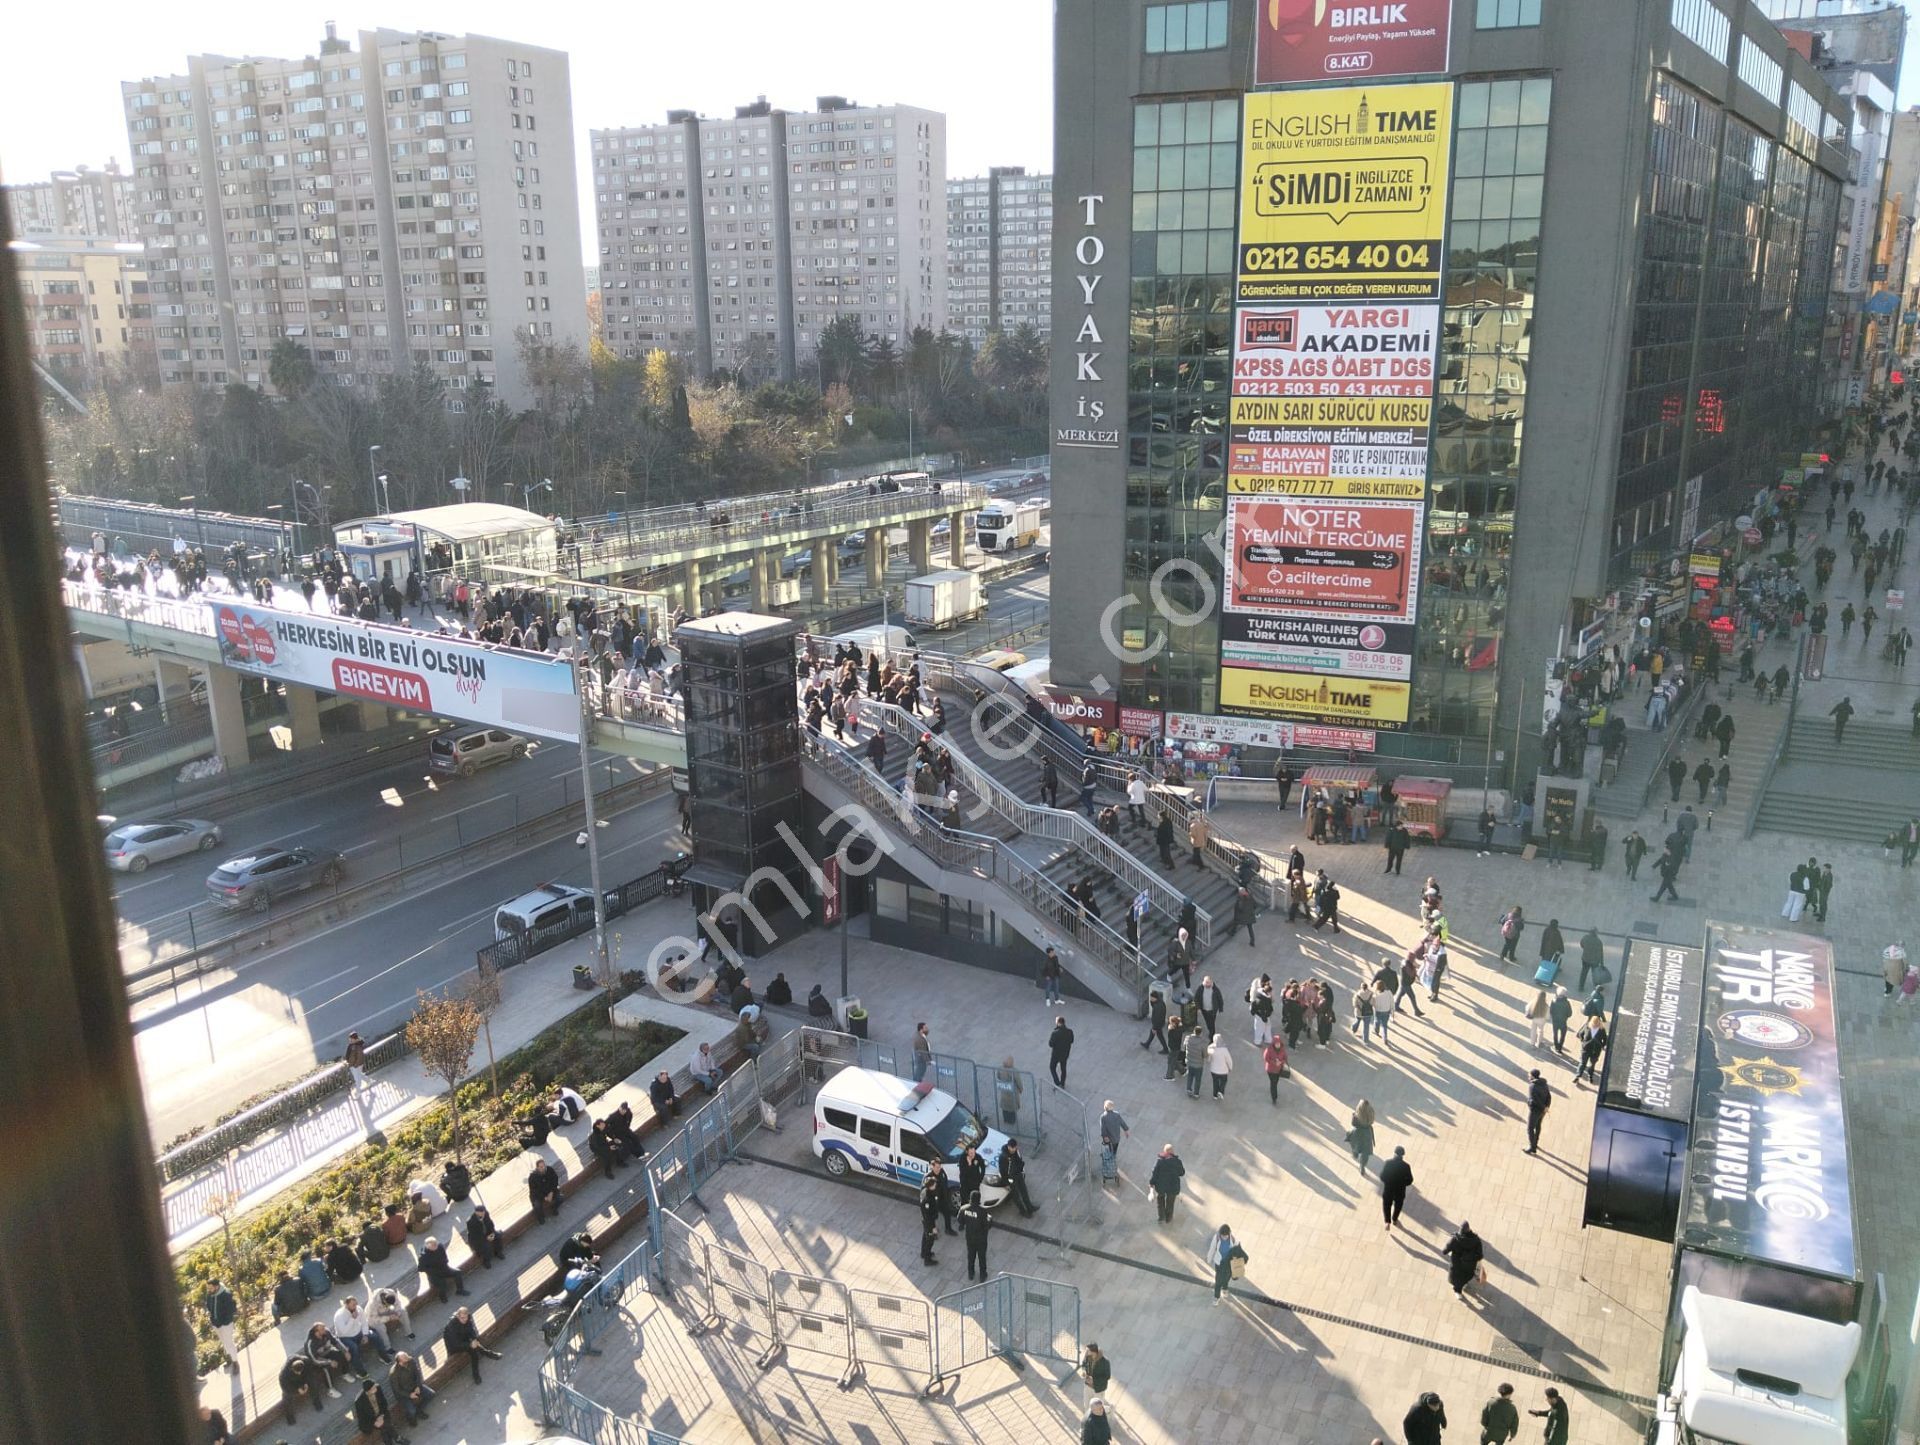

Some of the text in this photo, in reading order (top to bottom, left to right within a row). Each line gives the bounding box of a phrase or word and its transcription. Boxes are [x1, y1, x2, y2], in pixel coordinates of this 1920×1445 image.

[1329, 33, 1355, 43] Enerjiyi
[1409, 28, 1436, 37] Yükselt
[1330, 55, 1368, 69] 8.KAT
[1252, 110, 1437, 138] ENGLISH TIME
[1266, 140, 1292, 150] OKULU
[1294, 139, 1303, 148] VE
[1355, 186, 1412, 203] ZAMANI
[1246, 244, 1429, 270] 0212 654 40 04
[1076, 195, 1104, 381] TOYAK
[1299, 285, 1311, 295] EN
[1313, 285, 1332, 297] ÇOK
[1334, 283, 1363, 295] DEĞER
[1365, 284, 1395, 294] VEREN
[1397, 284, 1431, 294] KURUM
[1325, 309, 1409, 328] YARGI
[1301, 330, 1430, 352] AKADEMİ
[1235, 355, 1431, 377] KPSS AGS ÖABT DGS
[1239, 383, 1279, 395] 0212
[1284, 383, 1314, 395] 503
[1320, 383, 1340, 395] 50
[1344, 383, 1365, 395] 43
[1371, 385, 1402, 396] KAT
[1414, 385, 1424, 396] 6
[1236, 398, 1430, 422] AYDIN SARI SÜRÜCÜ KURSU
[1248, 426, 1413, 444] ÖZEL DİREKSİYON EĞİTİM MERKEZİ
[1262, 448, 1325, 459] KARAVAN
[1332, 449, 1349, 463] SRC
[1353, 449, 1364, 463] VE
[1331, 466, 1426, 476] BELGENİZİ ALIN
[1250, 479, 1334, 494] 0212 677 77 77
[1348, 482, 1415, 496] GİRİŞ KATTAYIZ
[1283, 508, 1361, 529] NOTER
[1241, 527, 1406, 549] YEMİNLİ TERCÜME
[1285, 571, 1373, 587] aciltercüme
[1248, 619, 1359, 635] TURKISH AIRLINES
[1247, 629, 1358, 646] TÜRK HAVA YOLLARI
[276, 620, 354, 656] HERKESİN
[359, 631, 386, 662] BİR
[390, 641, 418, 668] EVİ
[423, 649, 487, 681] OLSUN
[1372, 653, 1386, 664] 06
[1389, 654, 1403, 665] 06
[1249, 684, 1372, 708] ENGLISH TIME
[1050, 702, 1103, 719] TUDORS
[1716, 949, 1773, 1004] TIR
[1644, 949, 1688, 1107] İSTANBUL EMNİYET MÜDÜRLÜĞÜ
[1625, 1054, 1646, 1099] MÜDÜRLÜĞÜ
[1713, 1100, 1759, 1201] İSTANBUL
[904, 1159, 929, 1173] POLİ
